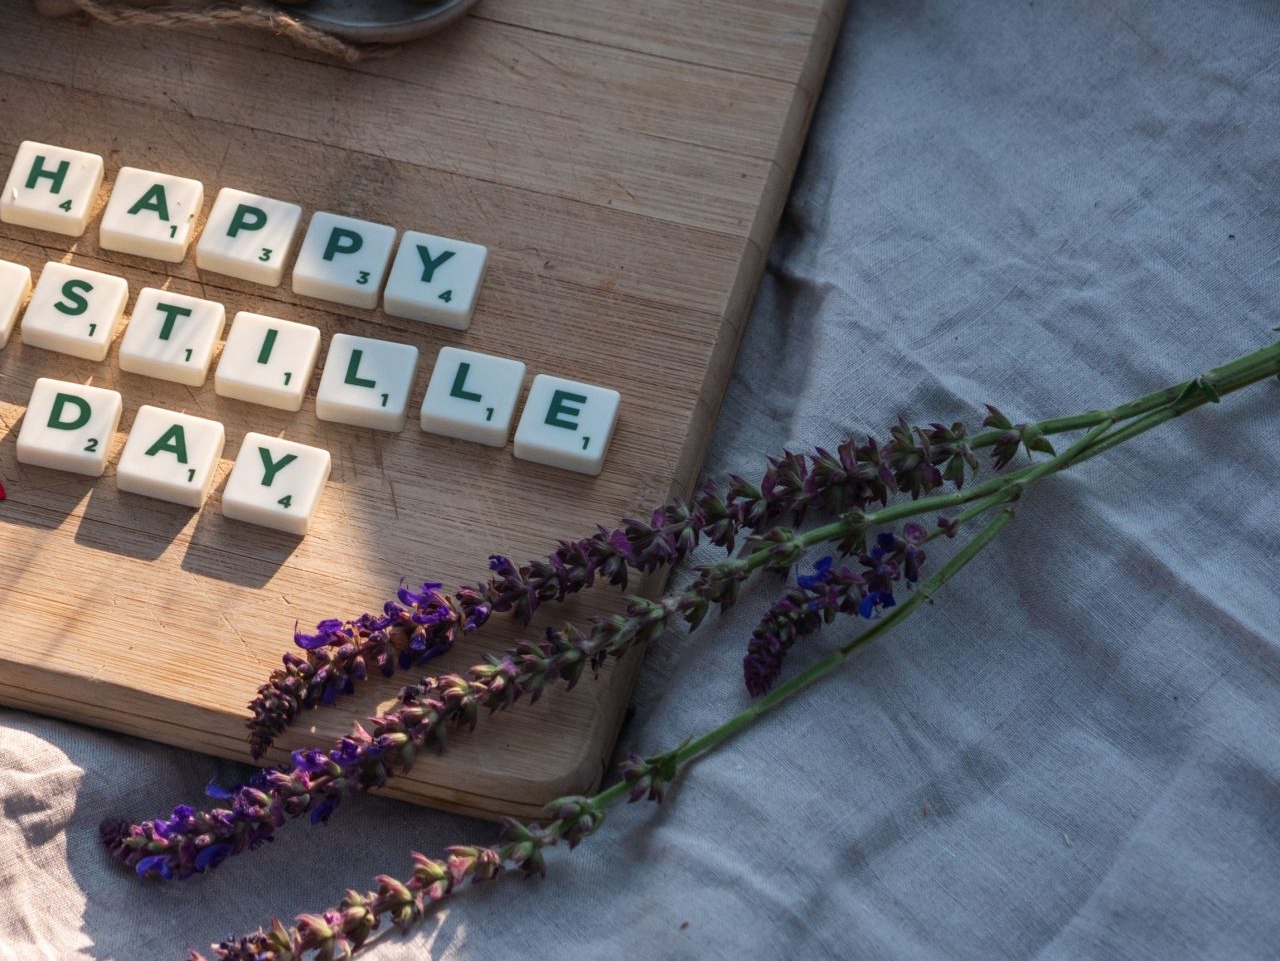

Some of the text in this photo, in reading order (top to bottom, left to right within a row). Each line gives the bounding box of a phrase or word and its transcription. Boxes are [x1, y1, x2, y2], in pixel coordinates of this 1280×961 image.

[58, 199, 72, 213] 4
[24, 154, 456, 284] HAPPY
[168, 225, 178, 238] 1
[258, 248, 272, 262] 3
[356, 271, 371, 285] 3
[437, 289, 452, 304] 4
[87, 323, 97, 337] 1
[184, 348, 193, 362] 1
[283, 371, 292, 386] 1
[380, 392, 389, 408] 1
[485, 407, 495, 422] 1
[46, 392, 298, 487] DAY
[83, 438, 99, 453] 2
[581, 436, 591, 451] 1
[186, 468, 196, 483] 1
[277, 495, 292, 509] 4
